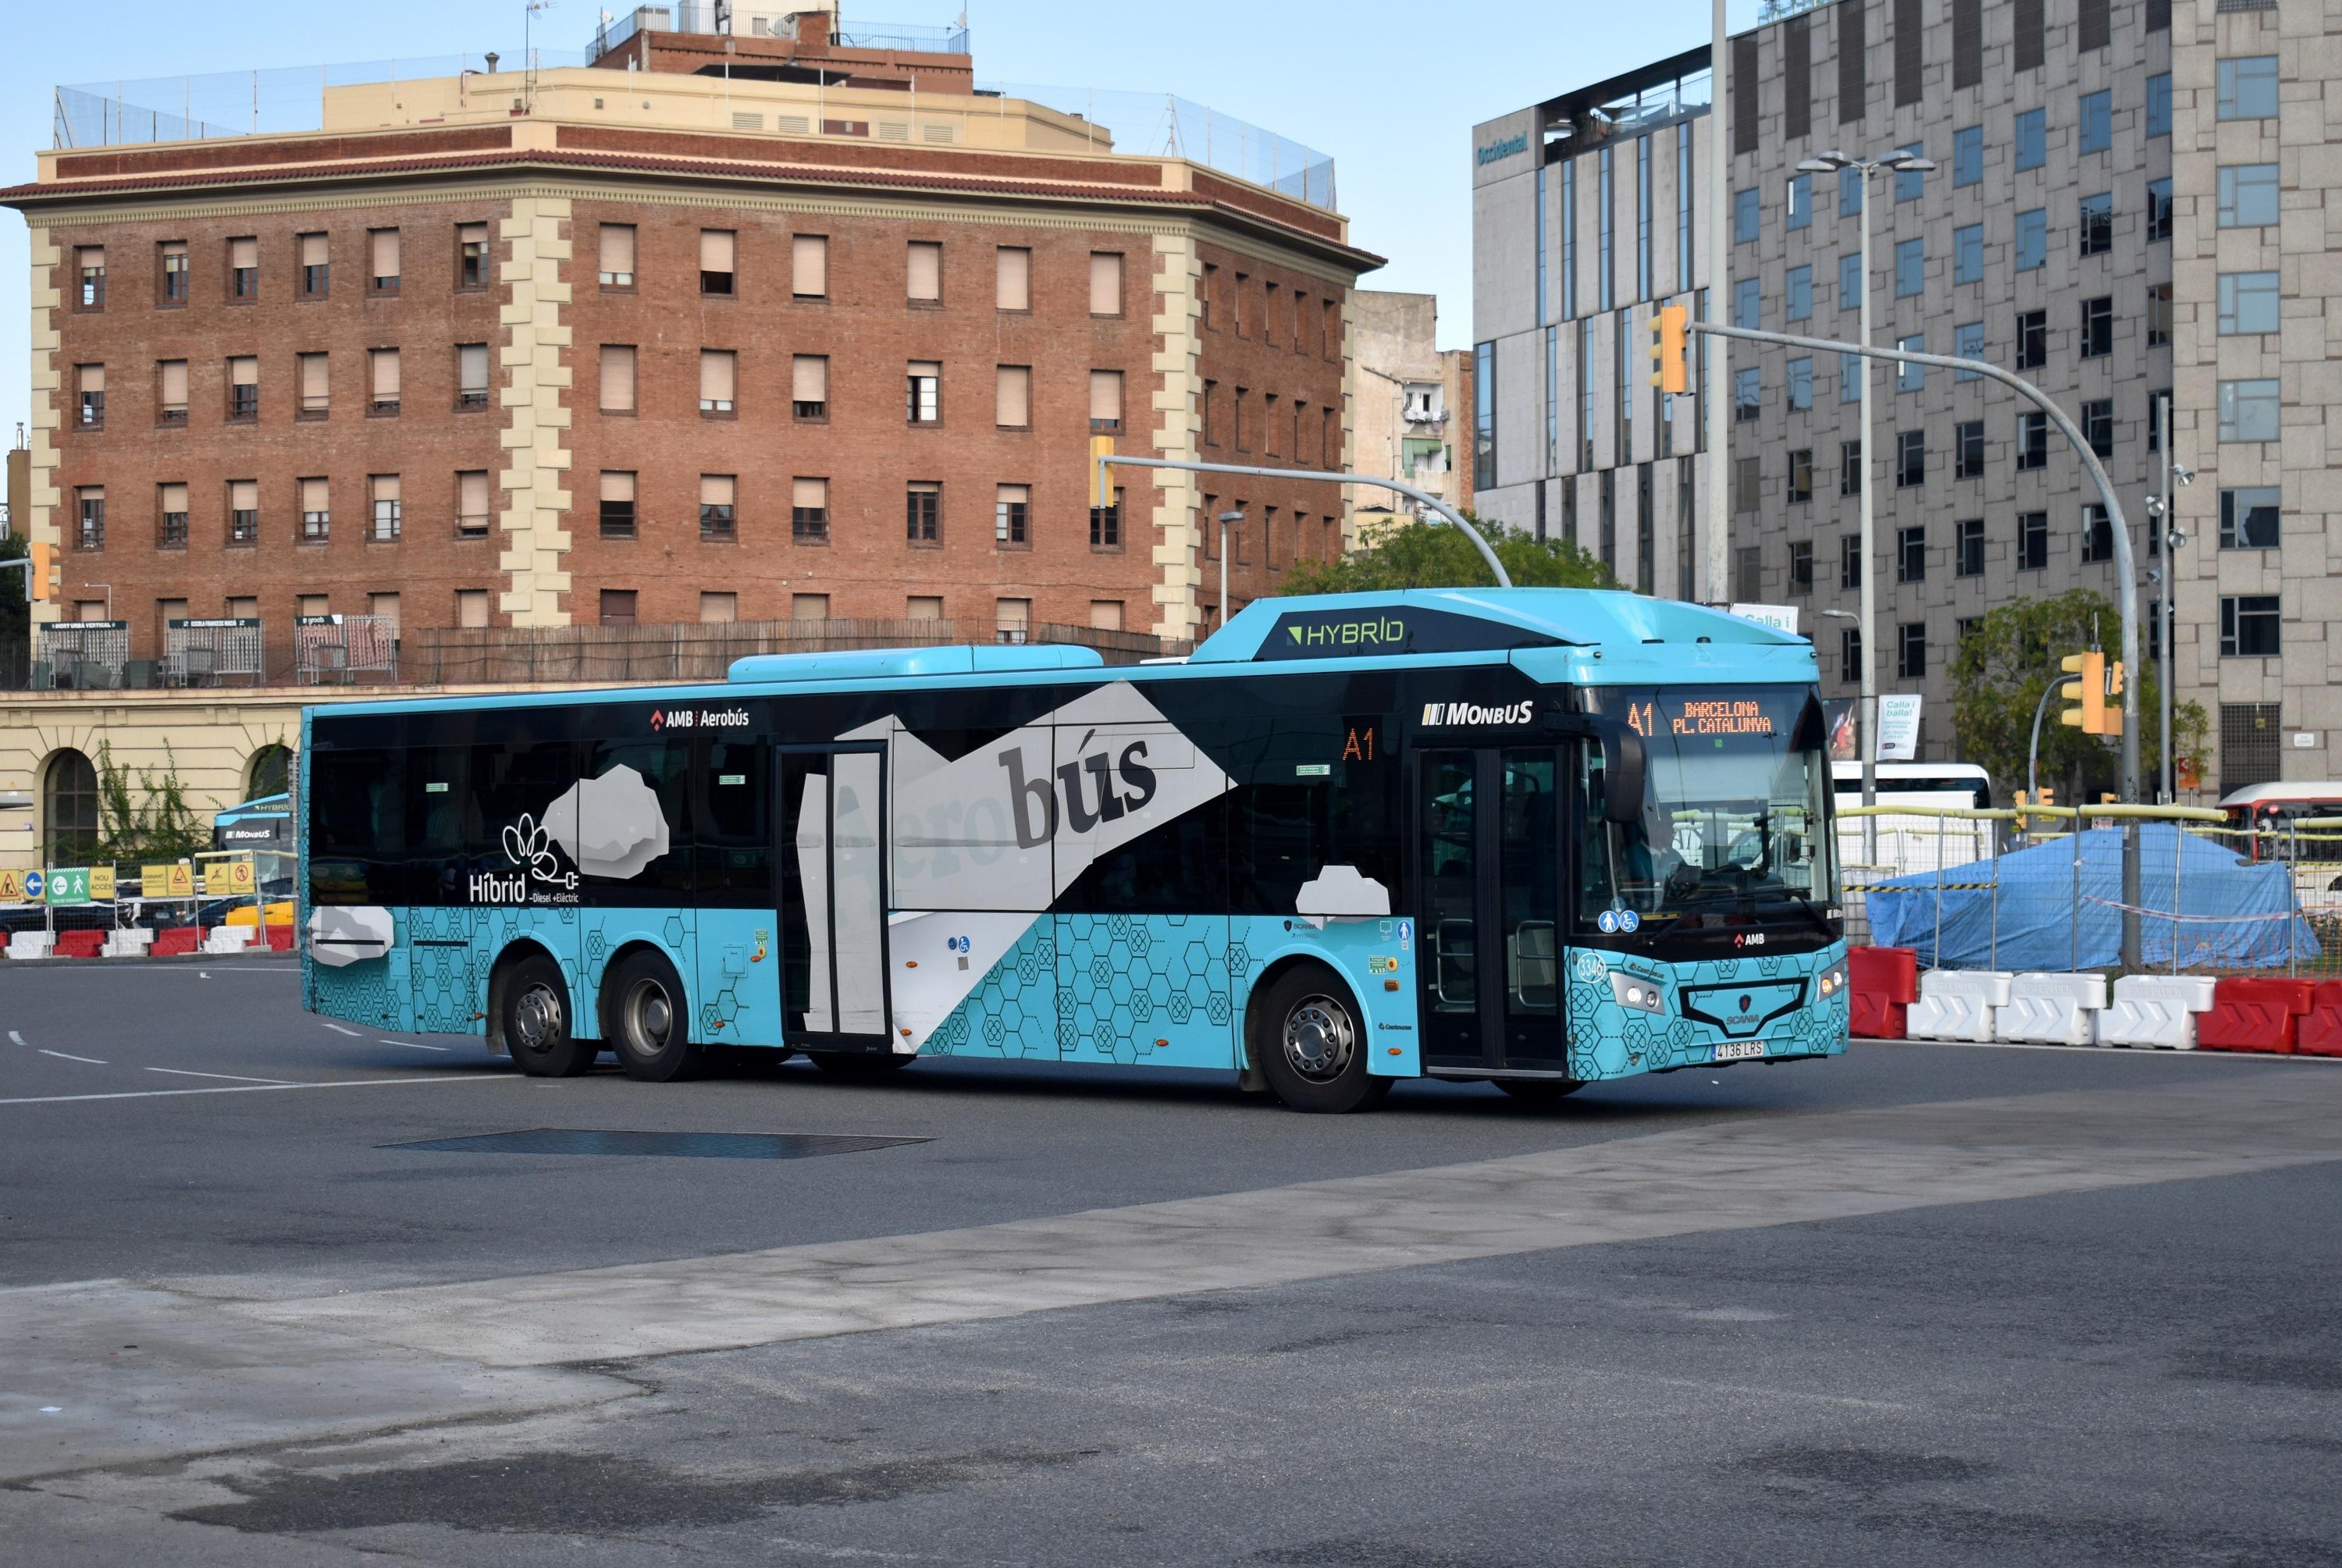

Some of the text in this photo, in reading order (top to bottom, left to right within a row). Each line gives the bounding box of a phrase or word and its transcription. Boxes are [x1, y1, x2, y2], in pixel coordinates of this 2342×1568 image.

[1478, 130, 1528, 166] Occidental
[1307, 616, 1404, 645] HYBRID
[666, 707, 749, 727] AMB Aerobús
[1685, 702, 1759, 717] BARCELONA
[1628, 702, 1653, 737] A1
[1673, 716, 1771, 734] PL. CATALUNYA
[1342, 727, 1373, 760] A1
[470, 872, 525, 902] Híbrid
[1745, 932, 1764, 945] AMB
[1580, 958, 1603, 976] 3346
[1726, 1015, 1760, 1025] SCANIA
[1717, 1041, 1762, 1058] 4136 LRS
